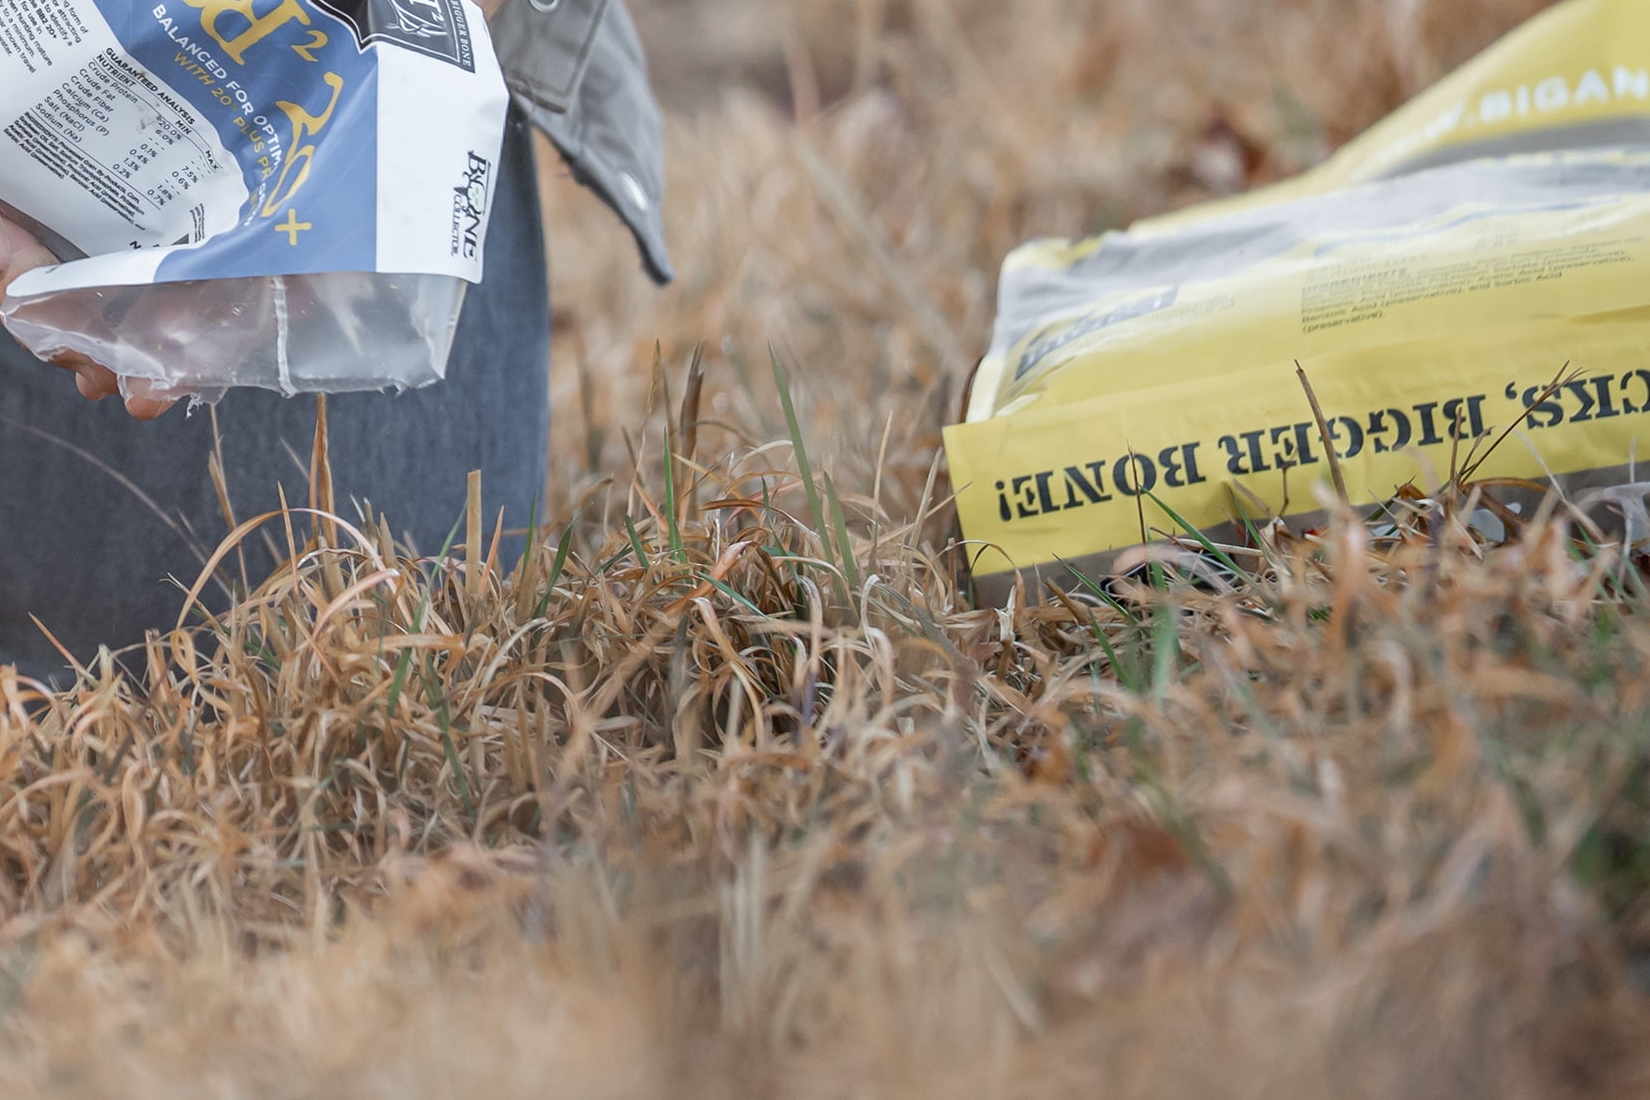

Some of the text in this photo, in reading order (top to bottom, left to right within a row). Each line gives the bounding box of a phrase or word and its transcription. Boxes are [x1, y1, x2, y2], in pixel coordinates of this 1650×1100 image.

[2, 8, 10, 17] to
[12, 23, 35, 58] minimum.
[4, 28, 21, 53] known
[20, 52, 37, 73] travel
[16, 12, 35, 41] hunting
[33, 41, 52, 66] mature
[20, 1, 29, 12] for
[27, 13, 37, 26] use
[36, 25, 43, 35] in
[36, 8, 48, 24] BB2
[45, 24, 57, 39] 20+
[44, 3, 52, 13] to
[50, 12, 69, 40] identify
[57, 9, 82, 43] attracting
[68, 7, 81, 26] form
[80, 26, 89, 34] of
[460, 38, 471, 67] BONE
[104, 46, 196, 126] GUARANTEED ANALYSIS
[150, 2, 227, 79] BALANCED
[225, 81, 254, 116] FOR
[43, 94, 60, 113] Salt
[57, 109, 86, 133] (NaCl)
[122, 156, 141, 172] 1.3%
[51, 87, 149, 165] Phosphorus (P) 0.4%
[60, 80, 191, 191] Calcium (Ca) 0.1% 0.6%
[68, 73, 199, 184] Crude Fiber 7.5%
[77, 66, 174, 146] Crude Fat 6.0%
[86, 59, 184, 141] Crude Protein 20.0%
[95, 52, 220, 171] NUTRIENT MIN MAX
[171, 51, 215, 88] WITH
[231, 115, 266, 154] PLUS
[34, 101, 167, 206] Sodium (Na) 0.2% 0.7%
[449, 193, 460, 257] COLLECTOR
[1218, 394, 1487, 477] BIGGER
[996, 441, 1207, 525] BONE!
